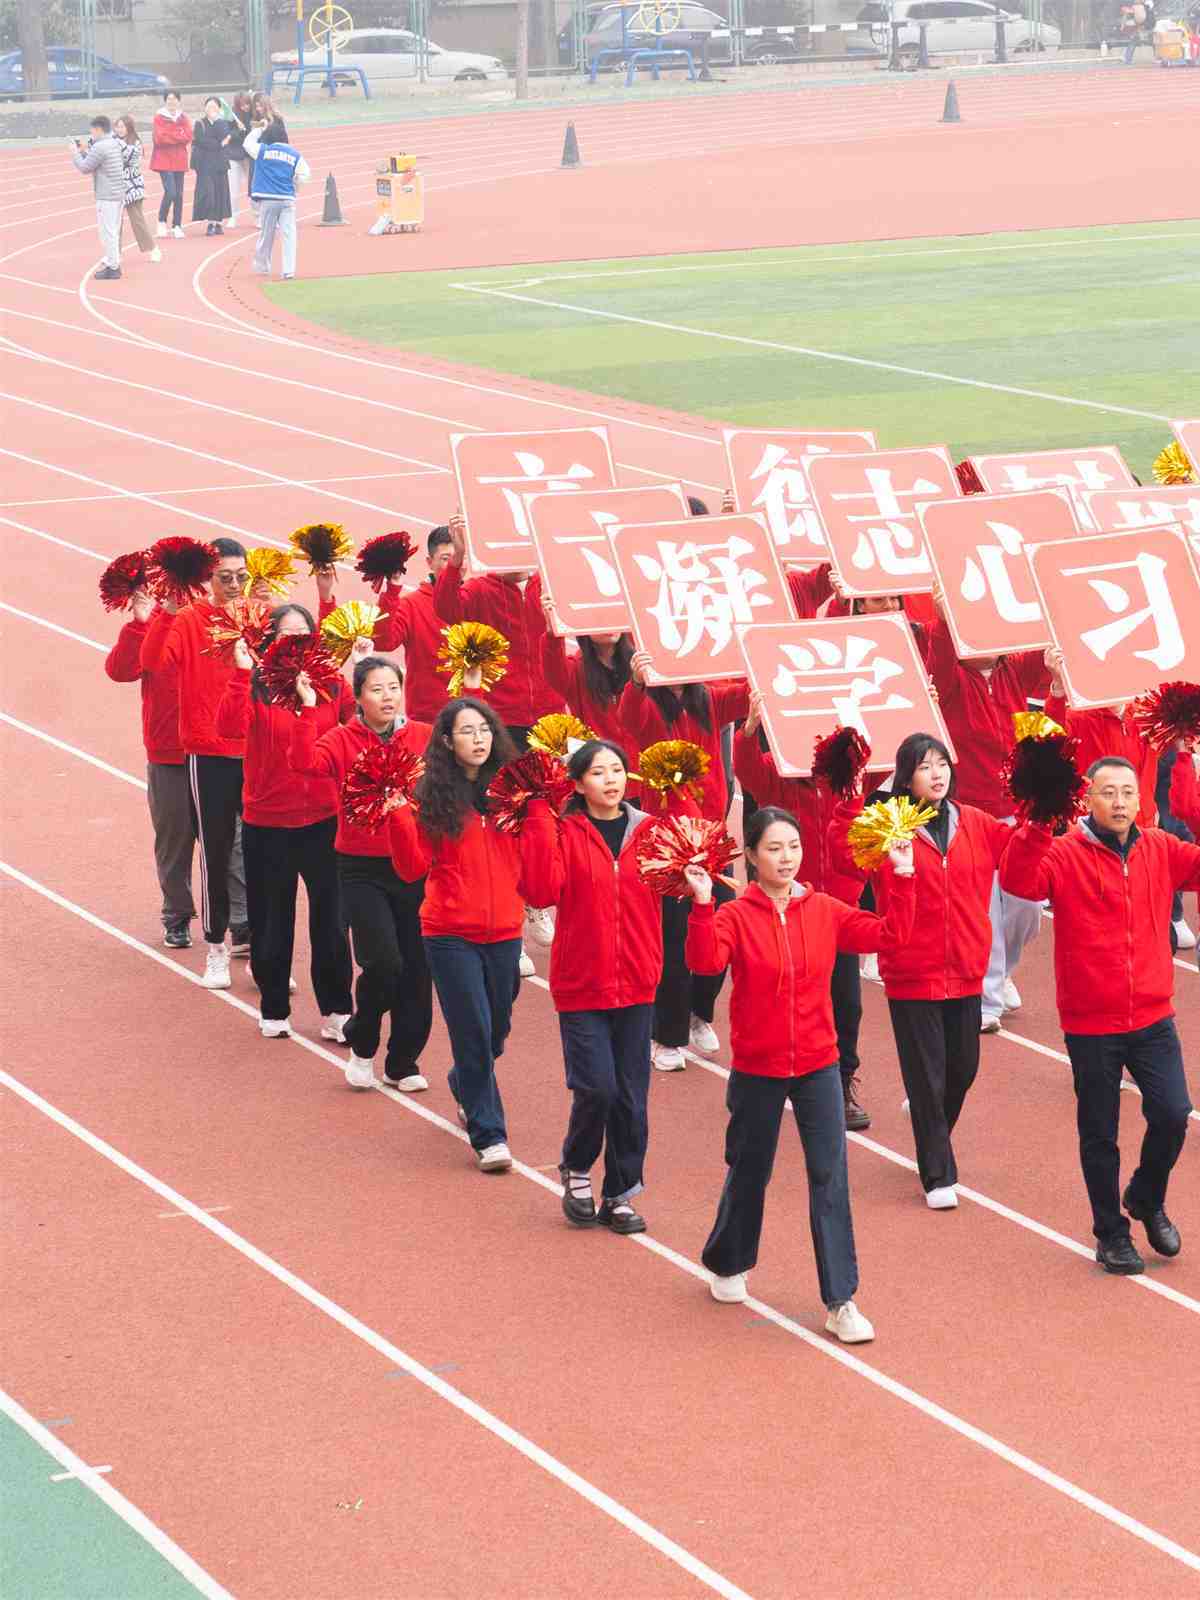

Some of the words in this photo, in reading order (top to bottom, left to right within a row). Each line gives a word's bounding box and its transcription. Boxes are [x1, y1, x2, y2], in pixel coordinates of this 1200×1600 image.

[831, 468, 943, 576] 志
[960, 520, 1044, 624] 心
[631, 535, 775, 658] 凝
[1058, 551, 1185, 672] 习
[772, 634, 915, 746] 学
